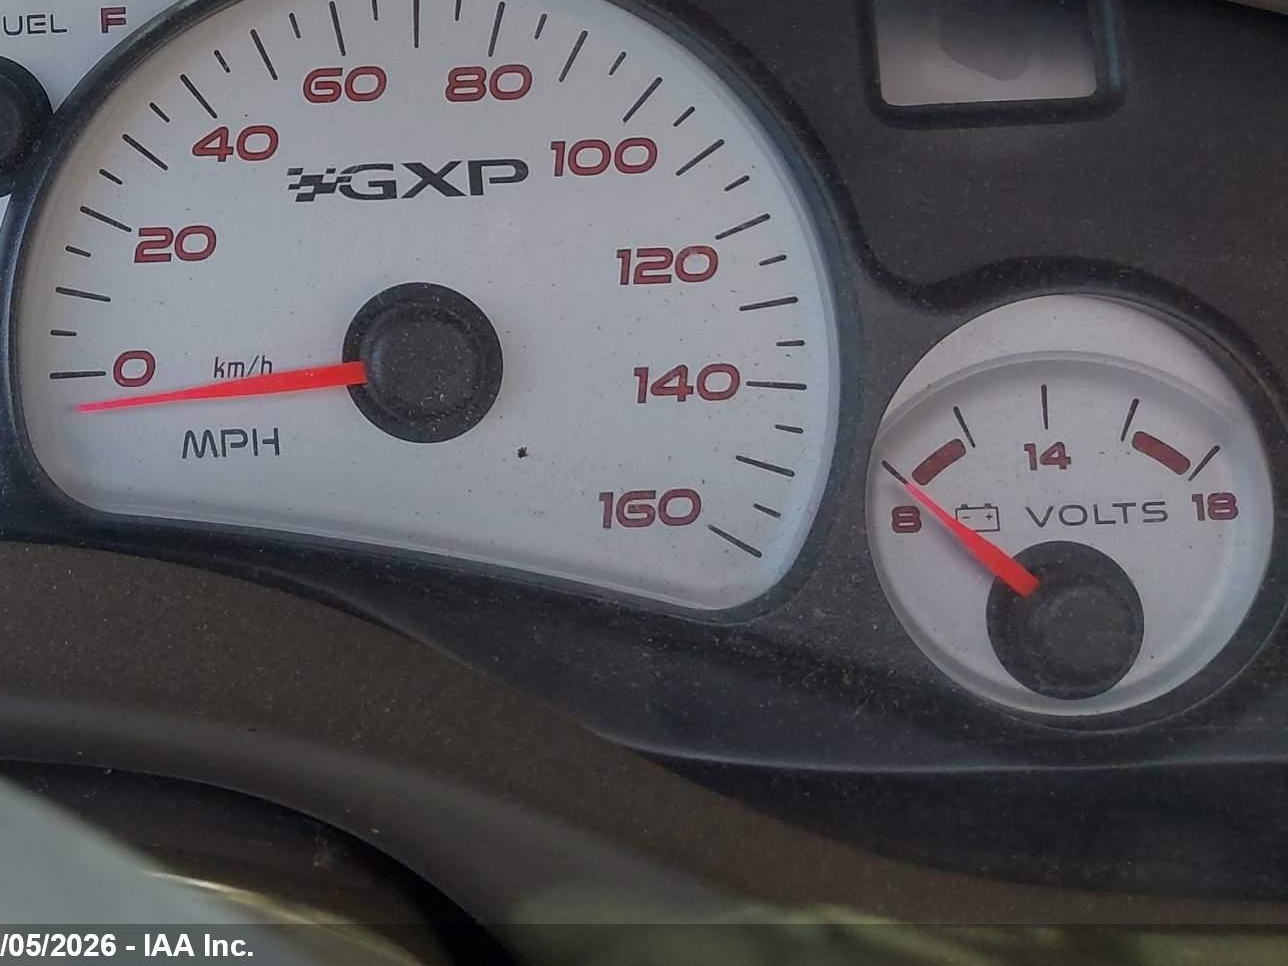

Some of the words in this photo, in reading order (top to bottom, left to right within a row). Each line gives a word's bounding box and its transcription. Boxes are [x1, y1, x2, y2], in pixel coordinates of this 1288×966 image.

[98, 6, 127, 34] F
[304, 66, 387, 102] 60
[445, 64, 533, 102] 80
[192, 126, 278, 163] 40
[550, 137, 658, 177] 100
[339, 159, 528, 201] GXP
[135, 226, 217, 264] 20
[618, 245, 719, 285] 120
[113, 351, 155, 387] 0
[212, 354, 273, 379] km/h
[634, 366, 740, 402] 140
[180, 426, 282, 460] MPH
[1022, 440, 1072, 471] 14
[600, 491, 702, 528] 160
[890, 504, 923, 535] 8
[1024, 501, 1170, 528] VOLTS
[1191, 491, 1240, 524] 18
